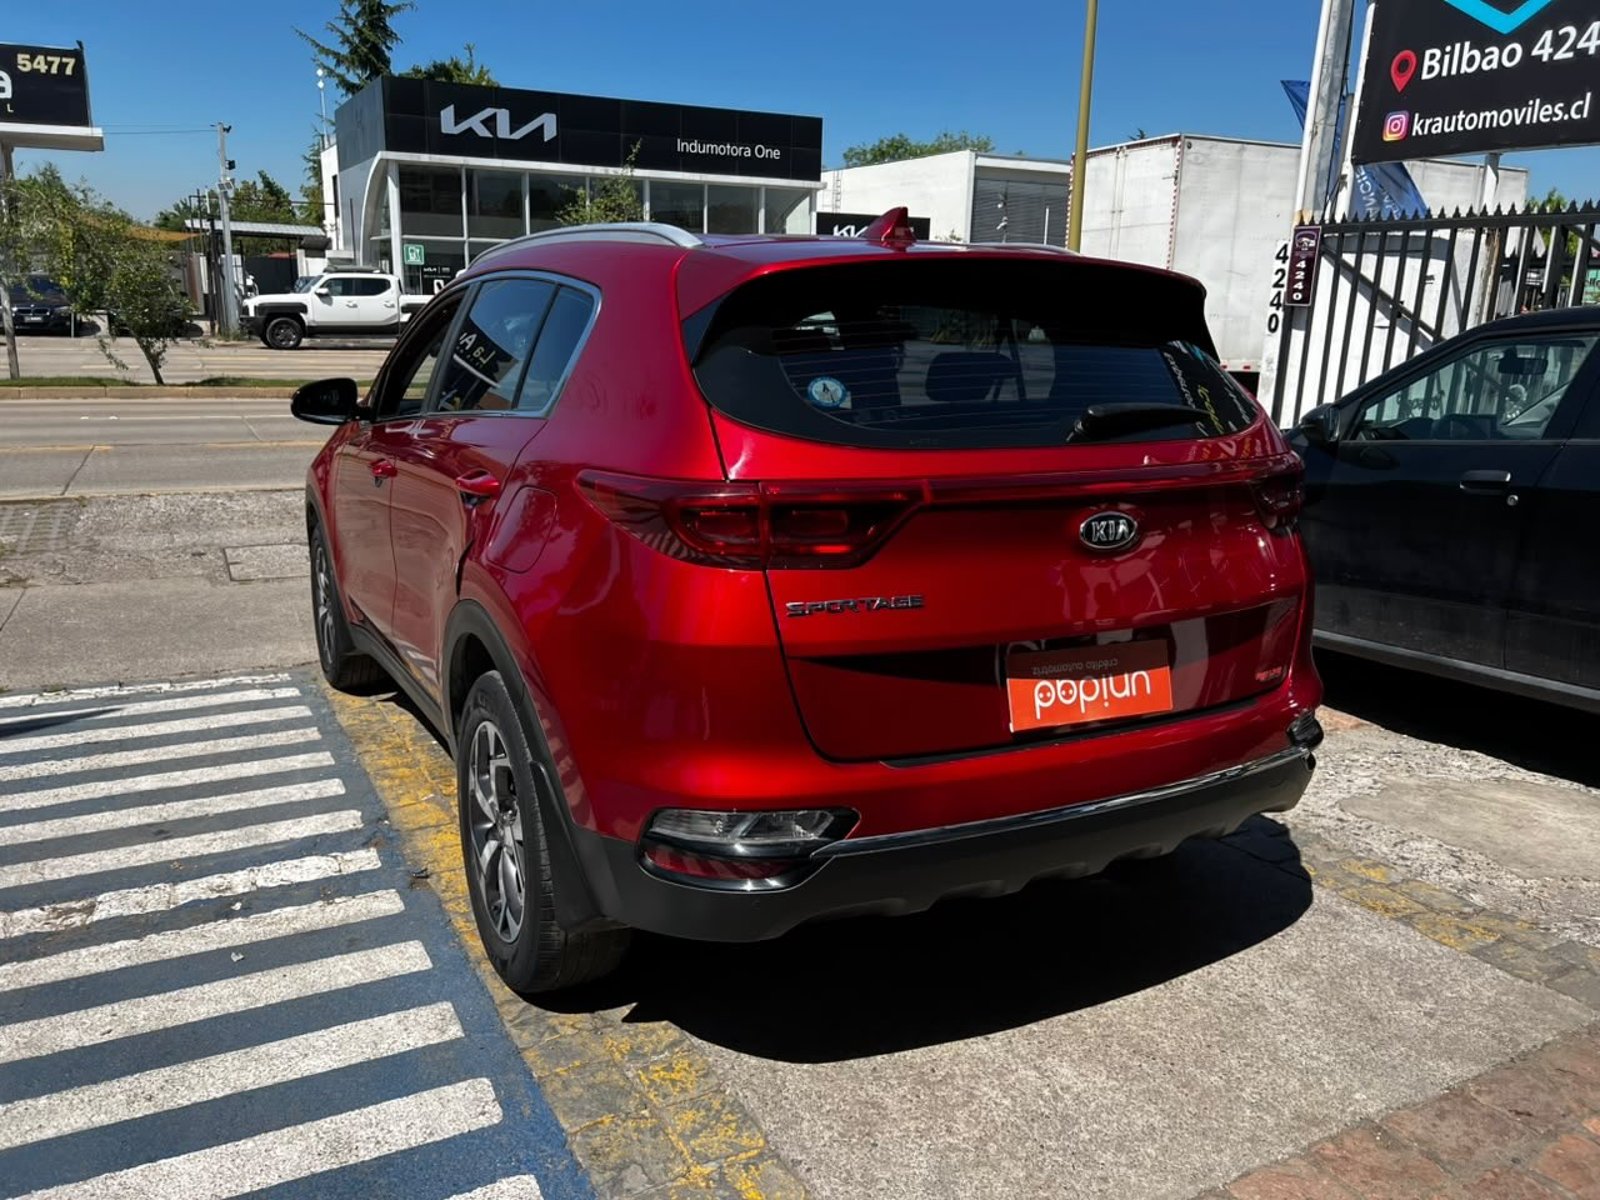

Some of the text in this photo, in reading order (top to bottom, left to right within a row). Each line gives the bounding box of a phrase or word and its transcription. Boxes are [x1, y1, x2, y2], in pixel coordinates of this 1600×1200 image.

[16, 53, 76, 76] 5477
[1421, 41, 1523, 81] Bilbao
[440, 104, 557, 142] KIA
[1412, 92, 1592, 137] krautomoviles.cl
[677, 138, 781, 160] Indumotora One
[1267, 243, 1289, 334] 4240
[1292, 260, 1307, 301] 4240
[1091, 519, 1130, 542] KIA
[785, 595, 925, 617] SPORTAGE
[1033, 670, 1152, 721] unidad
